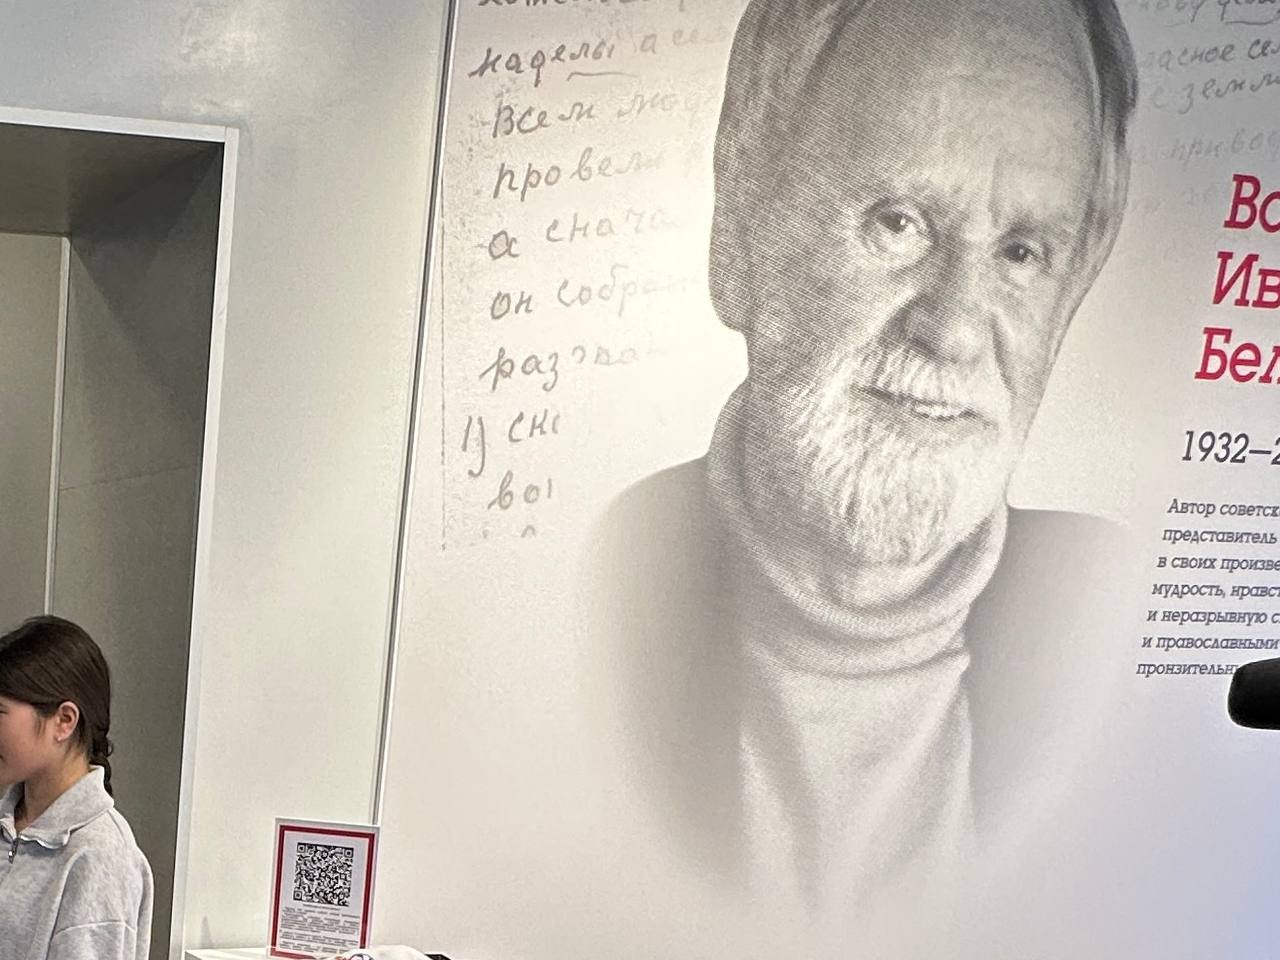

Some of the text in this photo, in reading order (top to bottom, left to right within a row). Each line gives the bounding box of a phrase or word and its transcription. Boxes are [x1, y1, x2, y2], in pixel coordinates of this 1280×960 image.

[1212, 251, 1280, 308] Ив
[1167, 498, 1216, 518] Автор
[1162, 527, 1278, 545] представитель
[1157, 556, 1167, 568] в
[1171, 556, 1217, 569] своих
[1152, 583, 1226, 599] мудрость,
[1147, 610, 1158, 622] и
[1161, 610, 1268, 626] неразрывную
[1141, 636, 1279, 651] и православными
